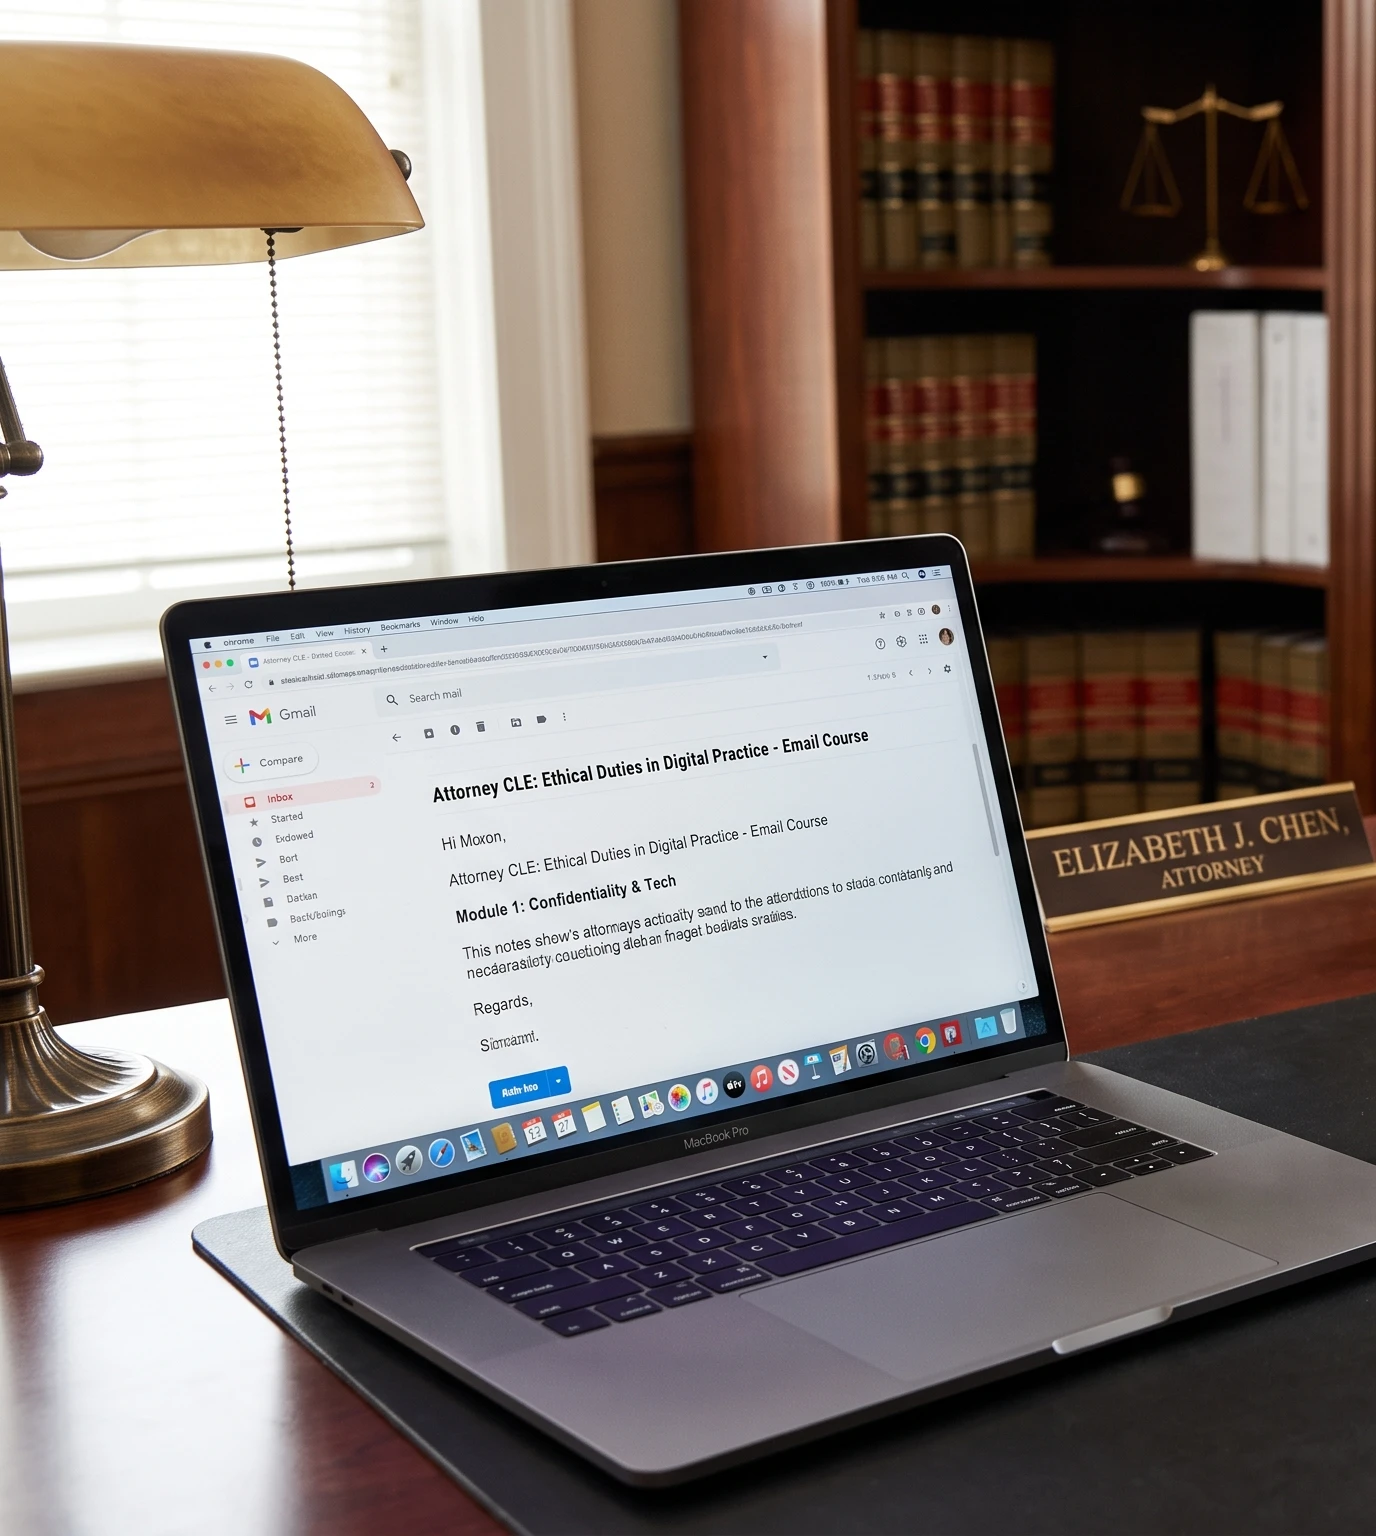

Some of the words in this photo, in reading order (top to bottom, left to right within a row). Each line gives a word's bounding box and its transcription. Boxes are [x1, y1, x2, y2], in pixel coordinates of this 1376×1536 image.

[266, 634, 280, 643] File
[315, 629, 334, 638] View
[344, 625, 371, 636] History
[430, 616, 459, 627] Window
[292, 653, 306, 662] CLE
[409, 689, 441, 704] Search
[443, 688, 463, 701] mail
[279, 705, 317, 721] Gmail
[259, 754, 304, 768] Compare
[433, 781, 499, 803] Attorney
[503, 773, 539, 793] CLE:
[541, 765, 594, 788] Ethical
[595, 759, 643, 779] Duties
[646, 757, 660, 773] in
[662, 749, 710, 772] Digital
[711, 742, 770, 764] Practice
[781, 733, 820, 754] Email
[822, 729, 869, 748] Course
[267, 792, 294, 804] Inbox
[271, 810, 304, 824] Started
[441, 836, 457, 851] Hi
[449, 867, 505, 888] Attorney
[507, 859, 542, 879] CLE:
[544, 851, 588, 873] Ethical
[590, 844, 632, 865] Duties
[634, 841, 646, 857] in
[648, 835, 688, 856] Digital
[690, 827, 740, 848] Practice
[750, 820, 785, 838] Email
[786, 814, 829, 832] Course
[1052, 824, 1226, 878] ELIZABETH
[1233, 821, 1254, 849] J.
[1259, 807, 1350, 844] CHEN,
[283, 872, 304, 884] Best
[1161, 853, 1265, 889] ATTORNEY
[455, 902, 509, 924] Module
[511, 900, 526, 915] 1:
[528, 884, 628, 912] Confidentiality
[631, 880, 642, 894] &
[644, 873, 677, 892] Tech
[462, 945, 492, 961] This
[495, 938, 532, 956] notes
[730, 897, 742, 912] to
[744, 896, 764, 910] the
[831, 881, 844, 895] to
[933, 861, 954, 877] and
[294, 932, 318, 944] More
[473, 995, 534, 1016] Regards,
[683, 1129, 731, 1150] MacBook
[731, 1126, 749, 1138] Pro
